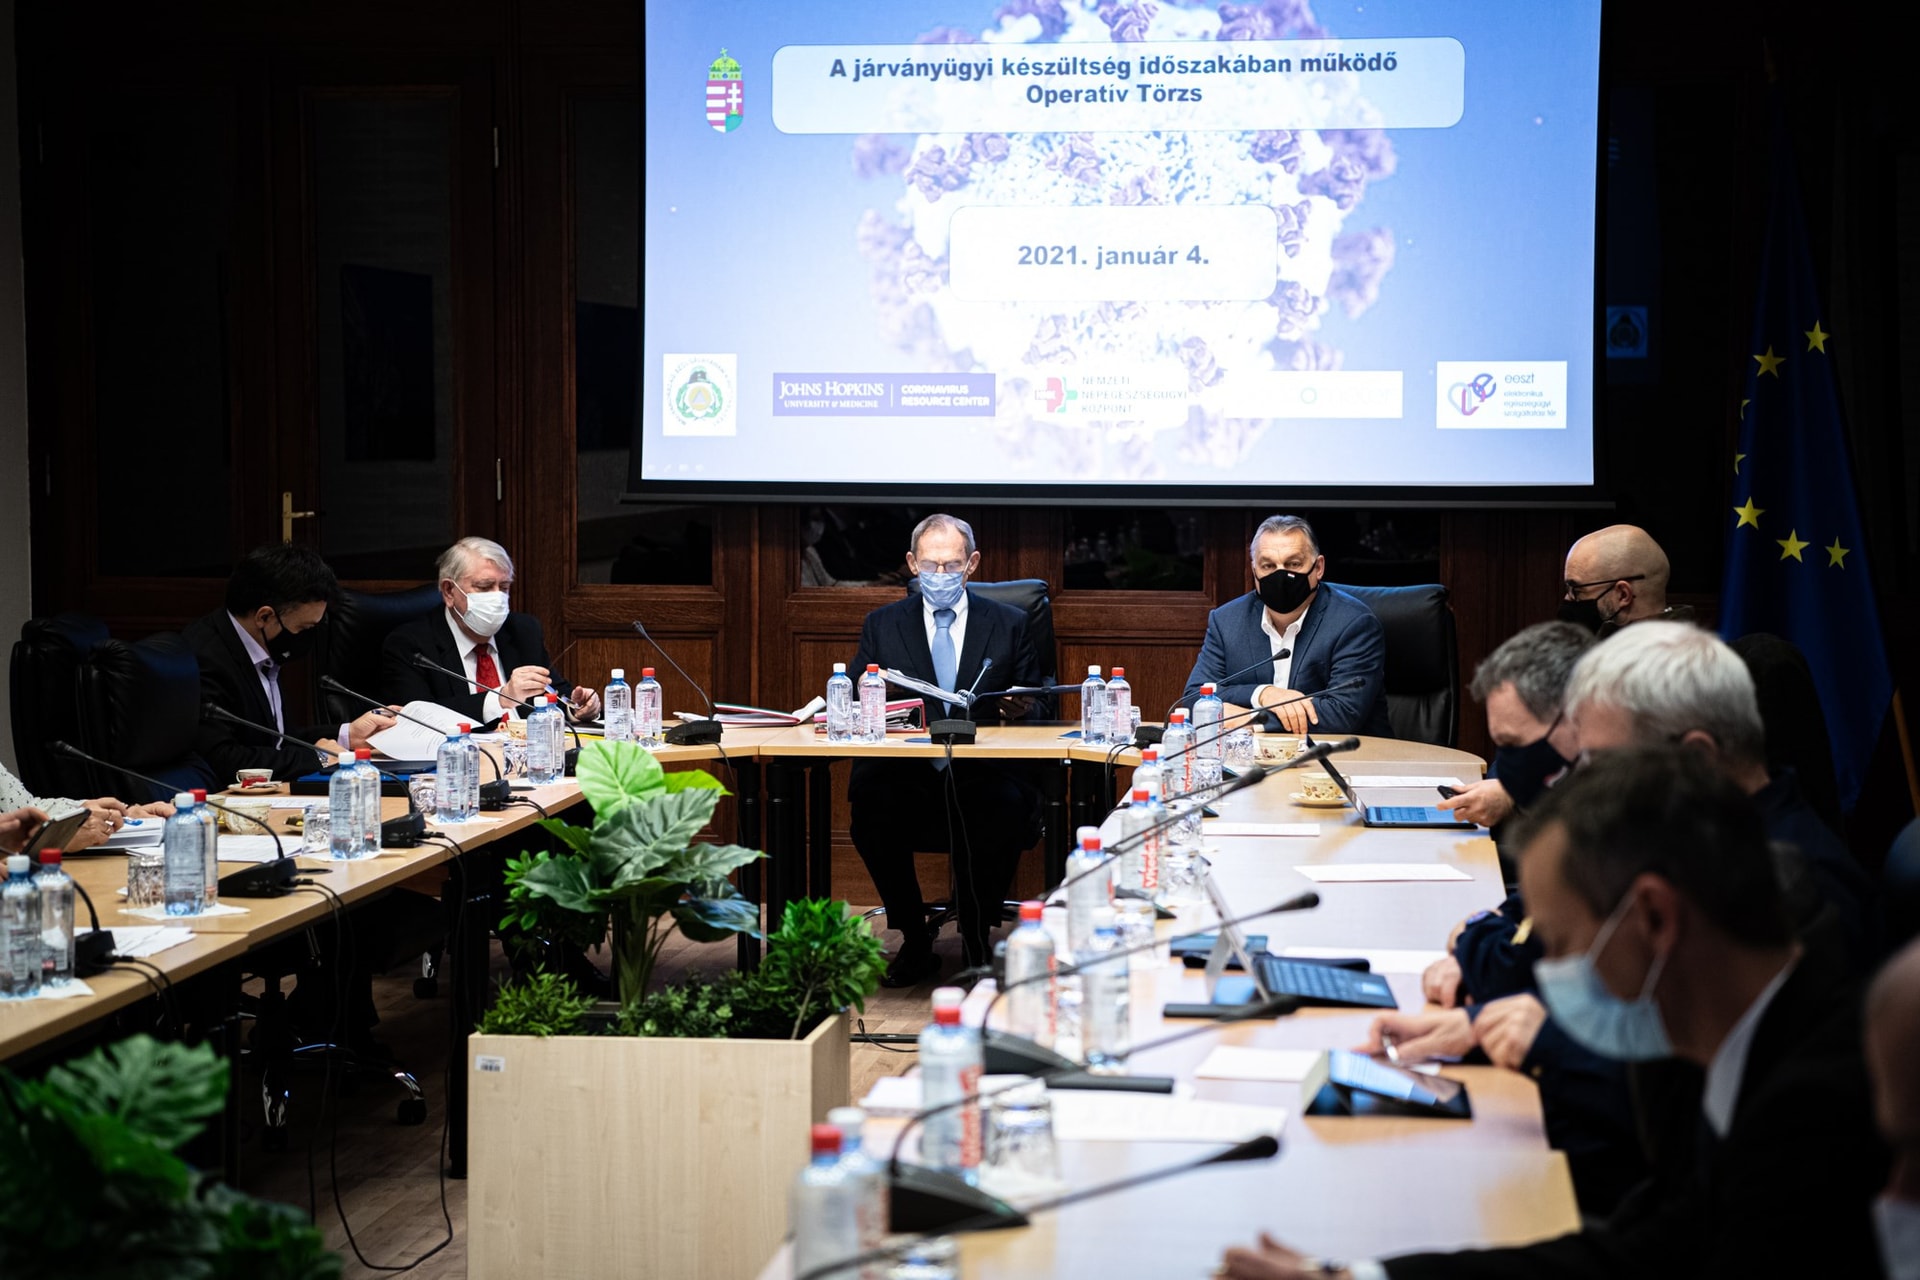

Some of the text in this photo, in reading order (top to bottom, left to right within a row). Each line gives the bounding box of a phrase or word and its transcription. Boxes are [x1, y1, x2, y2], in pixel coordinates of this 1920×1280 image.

[829, 51, 1398, 82] A járványügyi készültség időszakában működő
[1026, 84, 1203, 107] Operatív Törzs
[1018, 245, 1209, 270] 2021. január 4.
[1082, 375, 1130, 385] NEMZETI
[779, 381, 884, 399] JOHNS HOPKINS
[901, 384, 969, 395] CORONAVIRUS
[784, 400, 830, 408] UNIVERSITY
[840, 400, 879, 408] MEDICINE
[901, 396, 990, 407] RESOURCE CENTER
